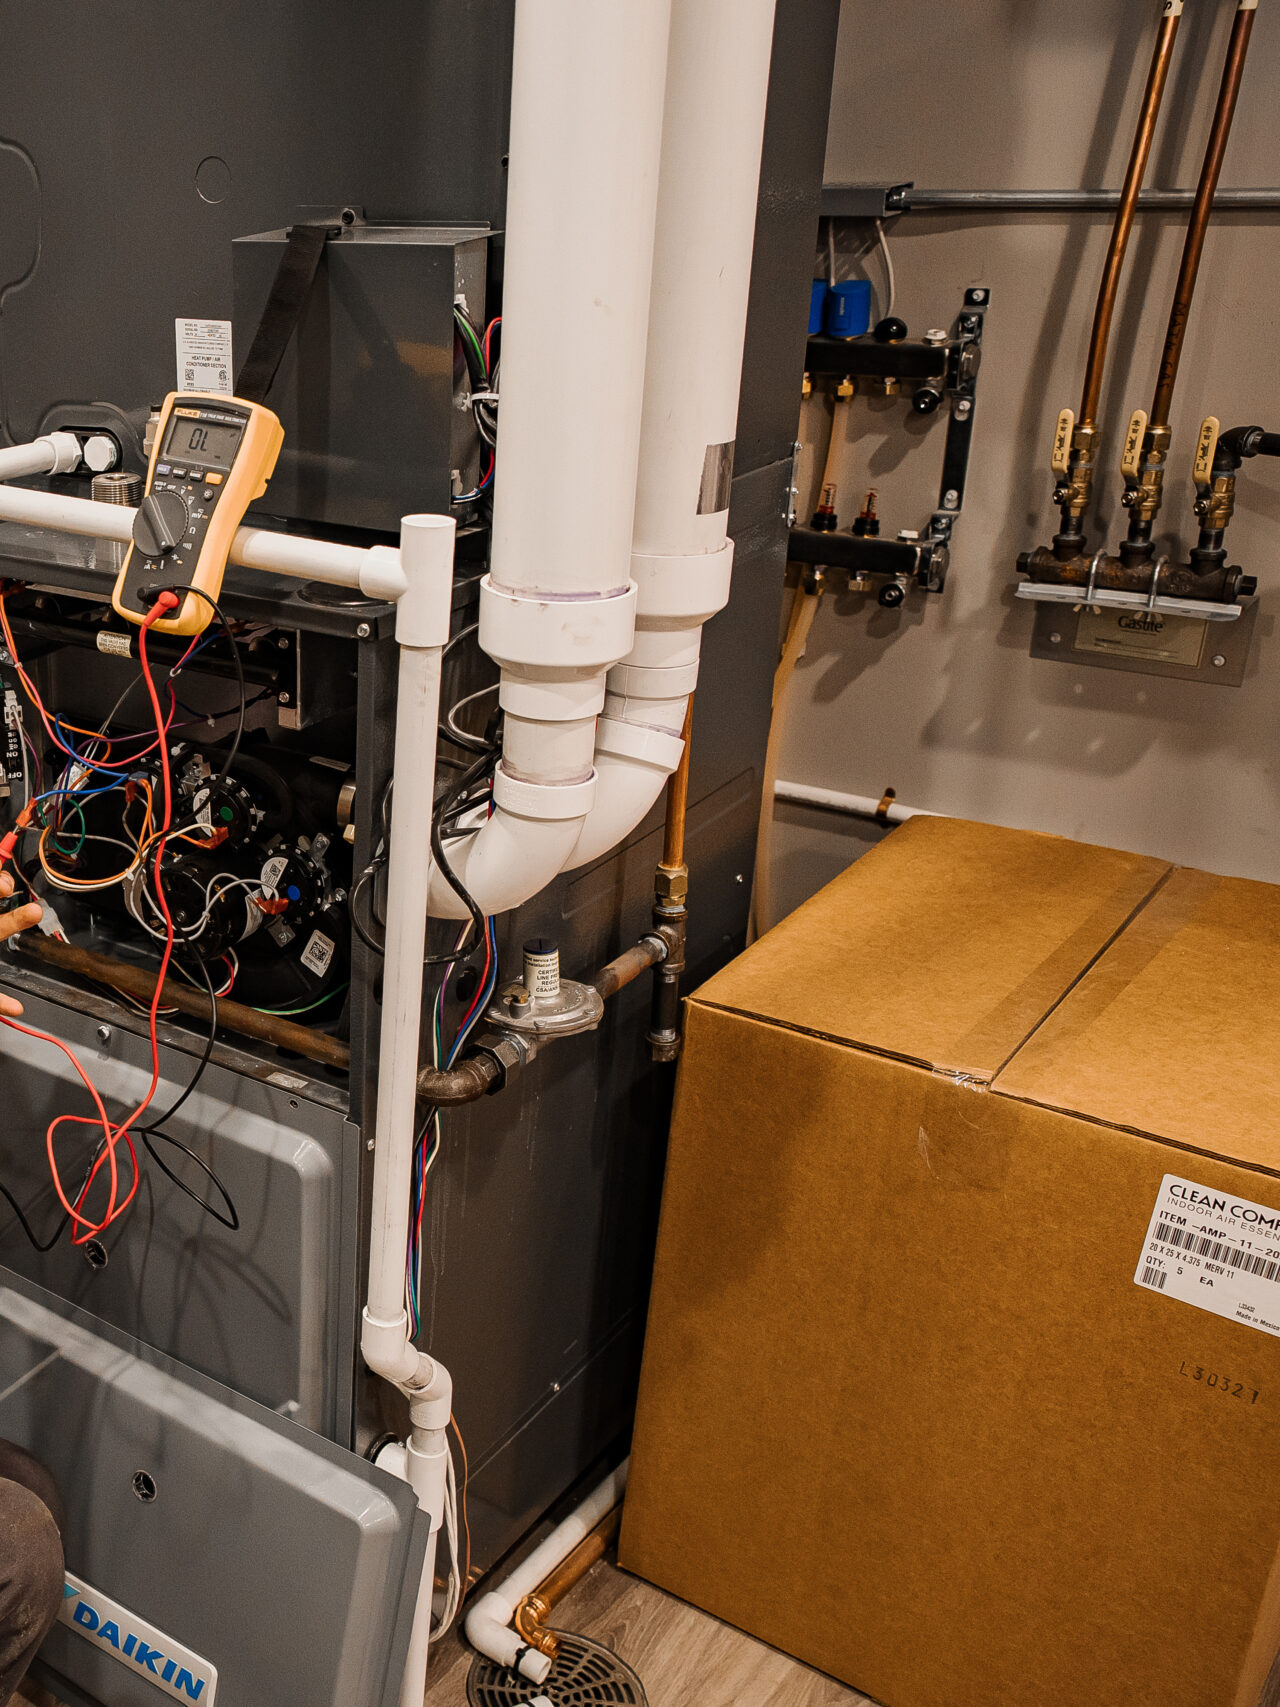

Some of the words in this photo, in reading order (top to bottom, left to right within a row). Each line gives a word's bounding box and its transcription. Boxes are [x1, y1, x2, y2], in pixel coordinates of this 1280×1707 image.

[176, 409, 198, 417] FLUKE
[1169, 1184, 1226, 1212] CLEAN
[1159, 1210, 1187, 1226] ITEM
[1167, 1196, 1213, 1218] INDOOR
[1216, 1214, 1236, 1226] AIR
[1145, 1255, 1166, 1269] QTY:
[1149, 1242, 1159, 1252] 20
[1159, 1245, 1166, 1254] X
[1165, 1248, 1174, 1257] 25
[1175, 1250, 1182, 1260] X
[1182, 1254, 1201, 1267] 4.375
[1204, 1261, 1225, 1276] MERV
[1226, 1270, 1235, 1279] 11
[1176, 1266, 1184, 1275] 5
[1199, 1276, 1214, 1287] EA
[1235, 1310, 1251, 1321] Made
[1260, 1319, 1280, 1331] Mexico
[73, 1600, 206, 1701] DAIKIN
